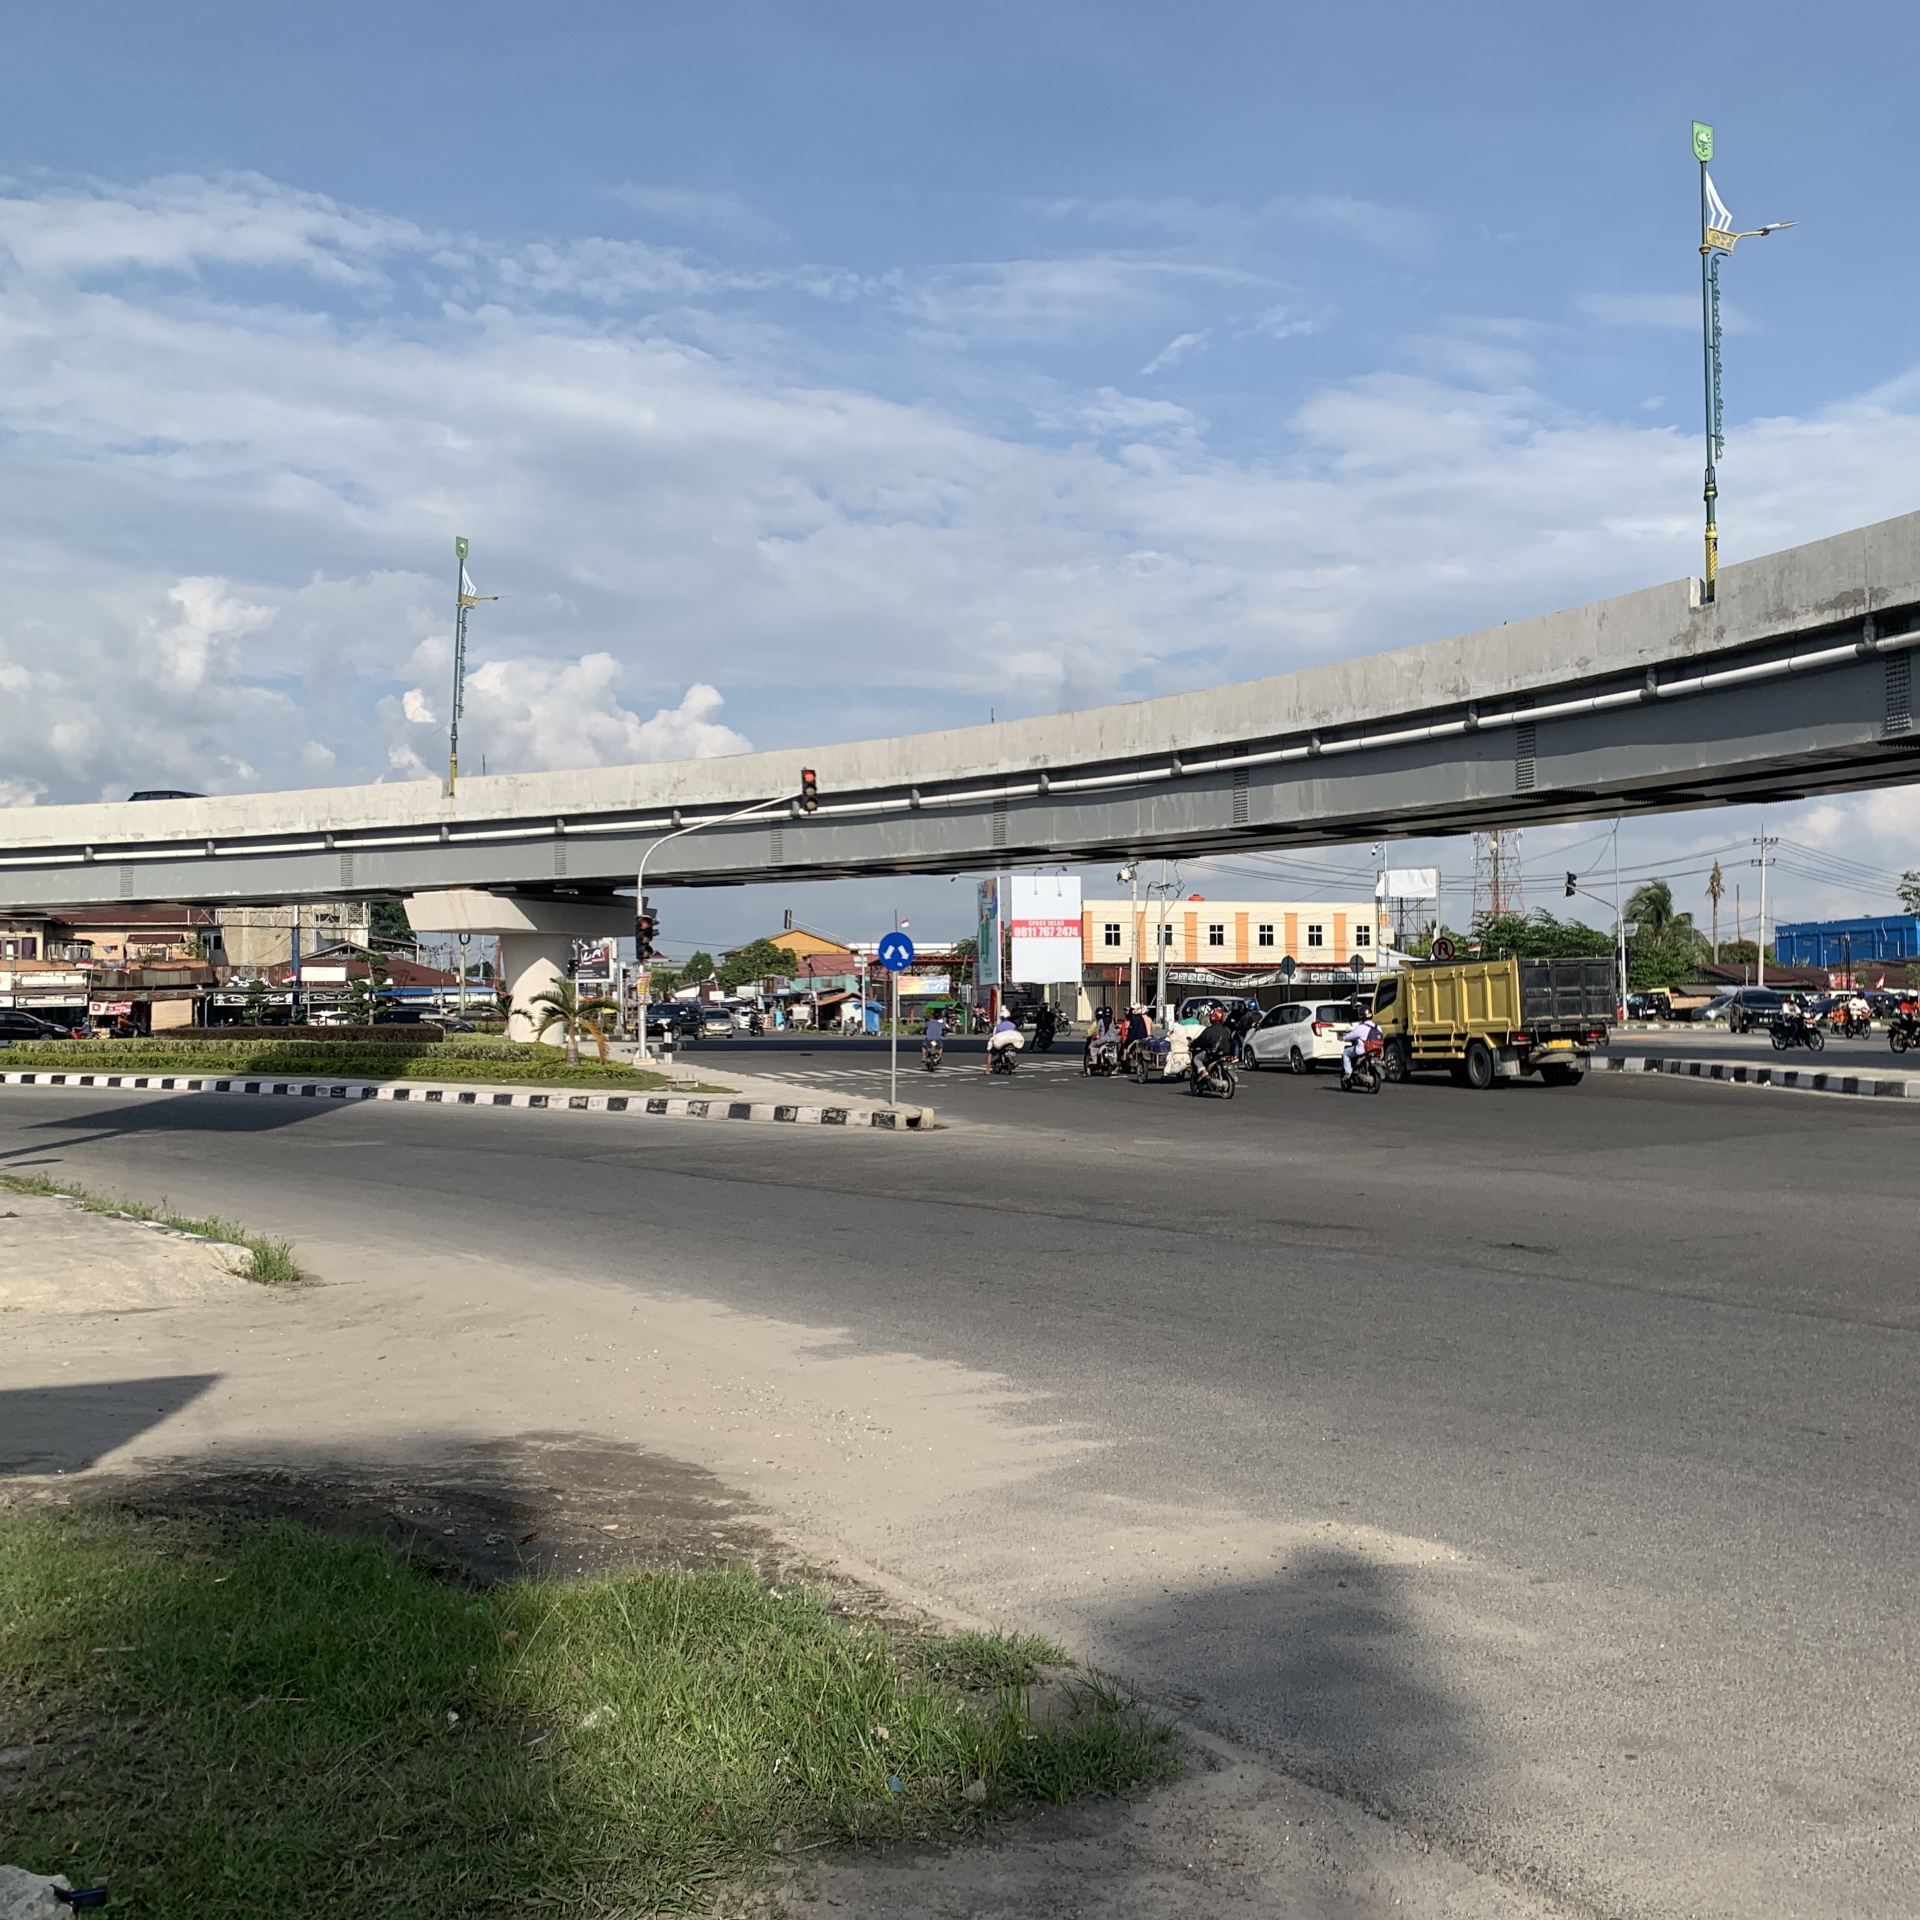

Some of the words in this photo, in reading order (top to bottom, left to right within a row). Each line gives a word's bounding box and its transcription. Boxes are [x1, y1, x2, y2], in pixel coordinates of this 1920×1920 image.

[1014, 926, 1037, 937] 0811
[1038, 926, 1055, 937] 767
[1056, 926, 1079, 937] 2474
[583, 949, 601, 961] LA
